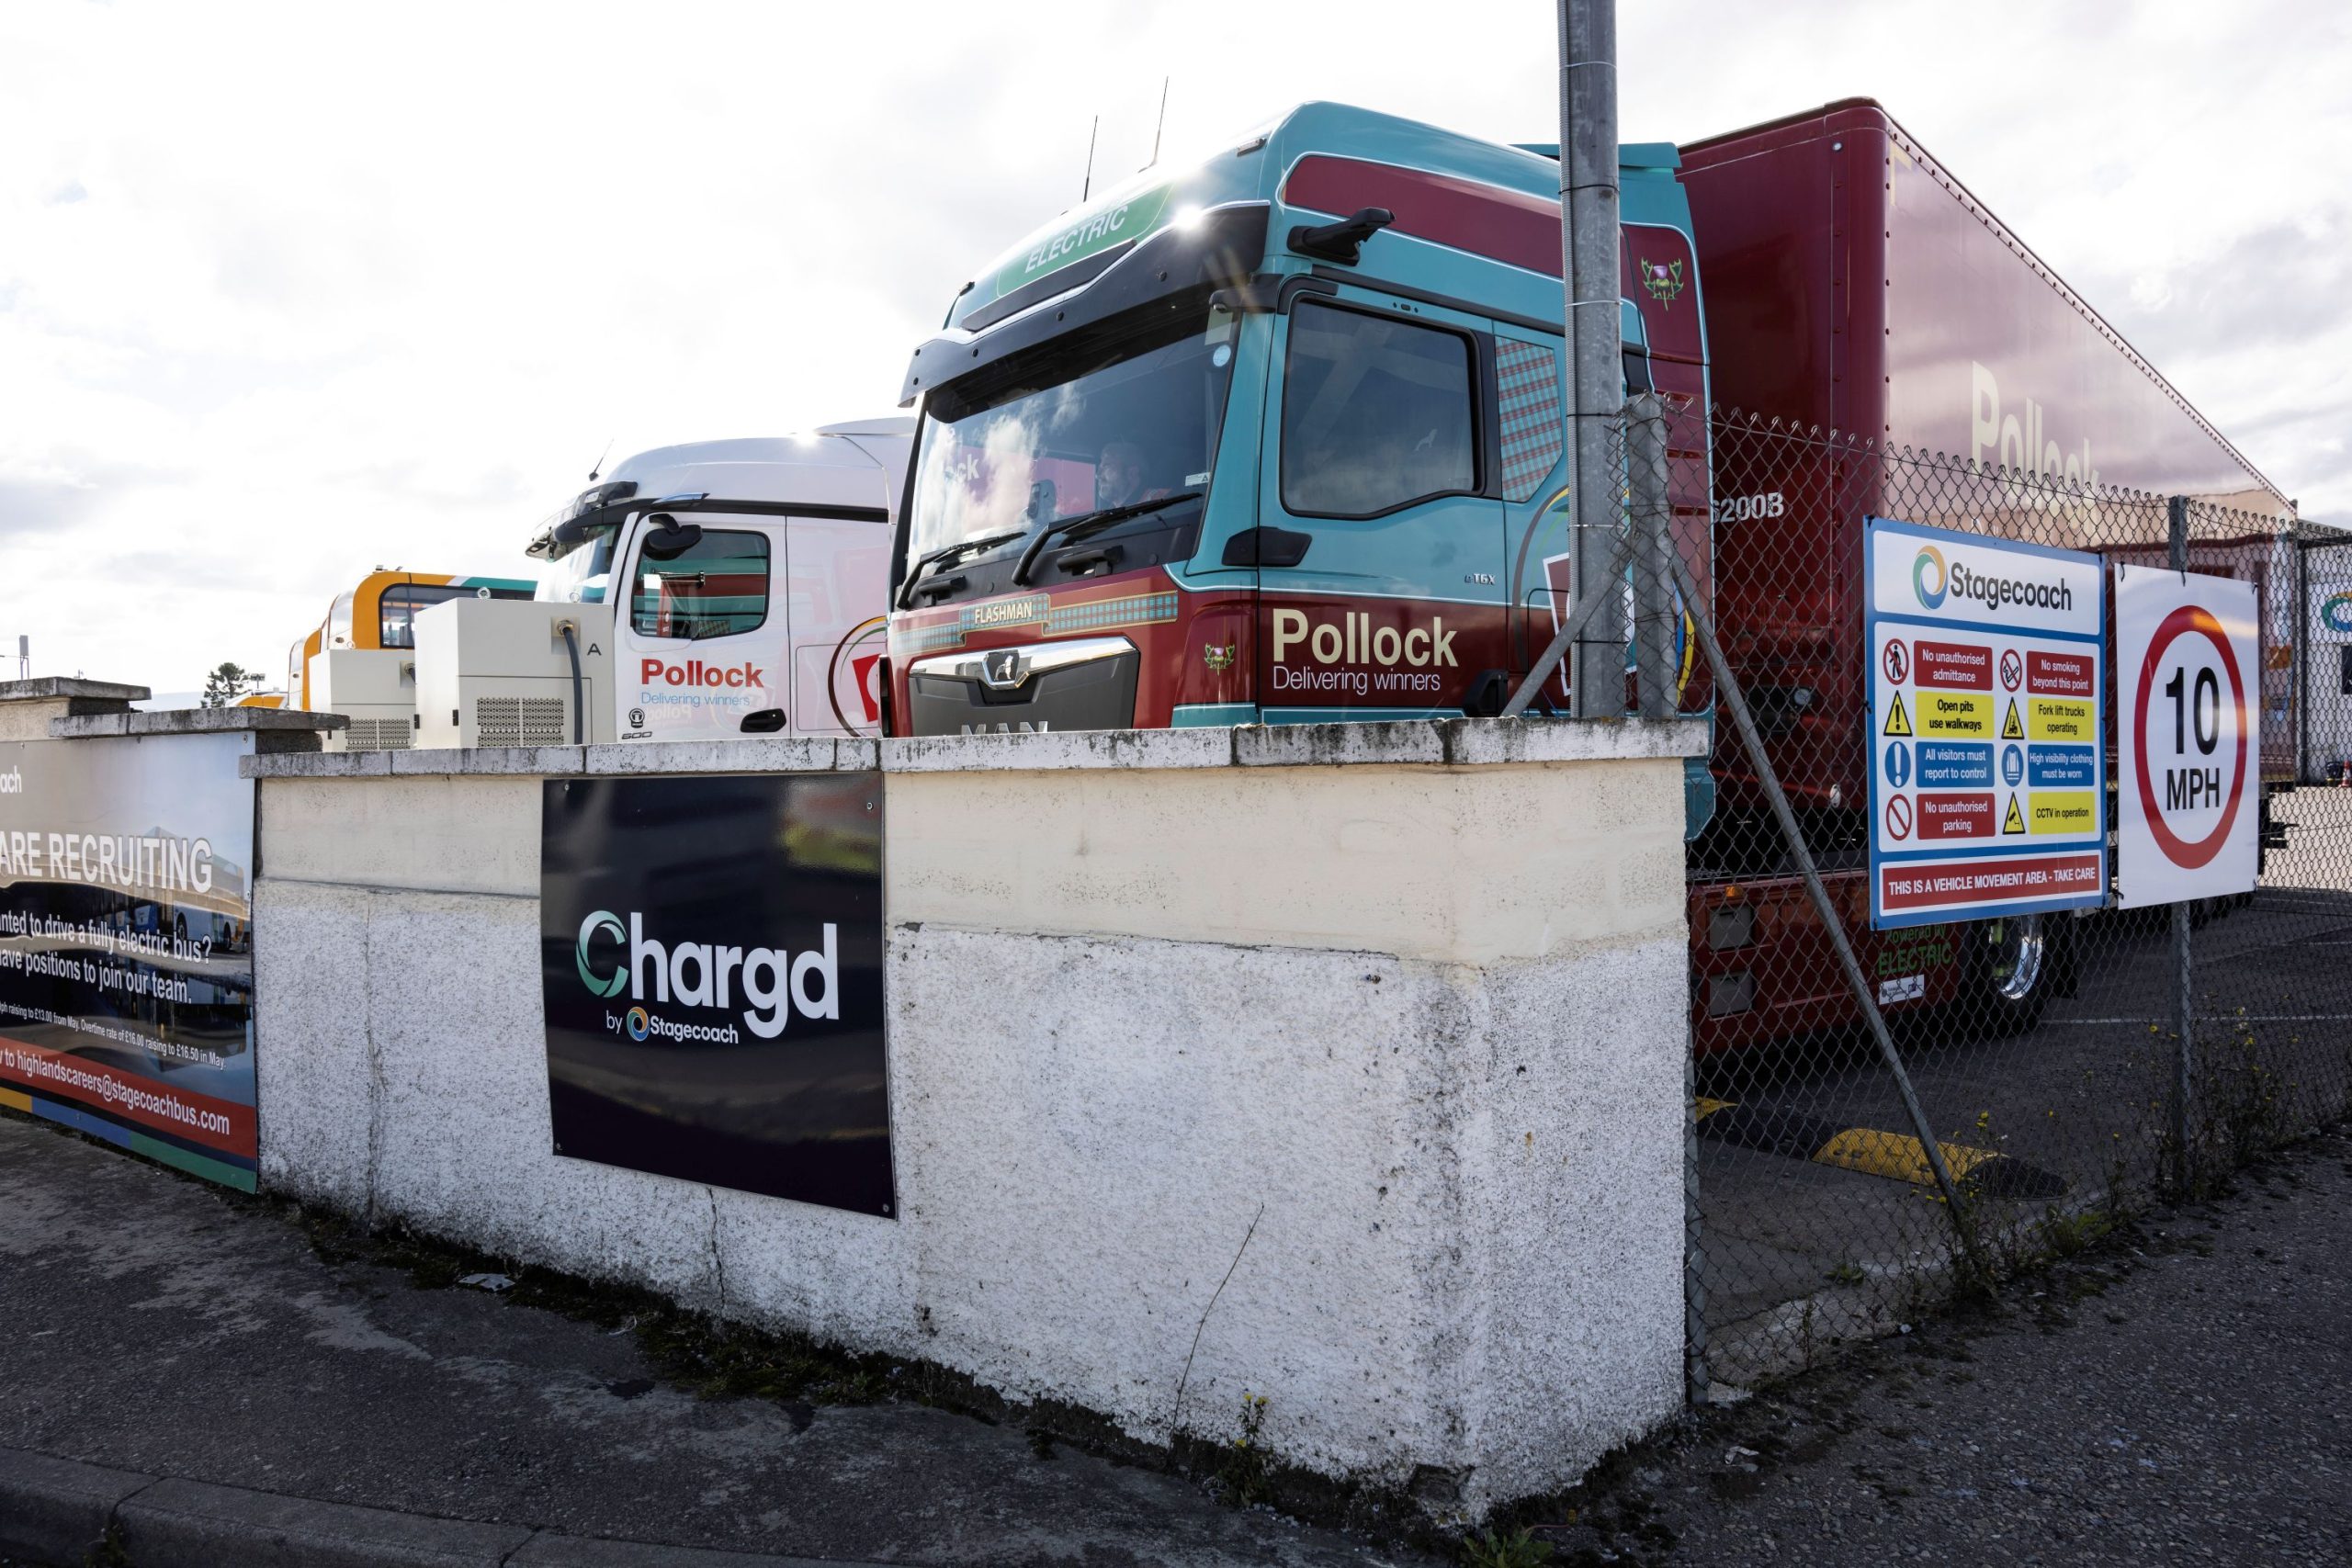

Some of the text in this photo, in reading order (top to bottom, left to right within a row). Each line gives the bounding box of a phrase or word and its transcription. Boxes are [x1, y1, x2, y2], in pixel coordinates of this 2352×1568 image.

[1024, 205, 1128, 273] ELECTRIC
[1950, 561, 2072, 611] Stagecoach
[975, 602, 1033, 625] FLASHMAN
[1272, 608, 1459, 668] Pollock
[587, 643, 602, 656] A
[1922, 648, 1985, 666] No unauthorised
[641, 659, 764, 688] Pollock
[1932, 669, 1976, 682] admittance
[2041, 659, 2081, 675] No smoking
[1273, 665, 1441, 695] Delivering winners
[2032, 675, 2088, 692] beyond this point
[640, 692, 751, 707] Delivering winners
[1937, 698, 1974, 714] Open pits
[2038, 704, 2086, 716] Fork lift trucks
[2165, 667, 2221, 755] 10
[1929, 717, 1982, 732] use walkways
[2047, 723, 2078, 735] operating
[1925, 748, 1986, 761] All visitors must
[2030, 752, 2093, 765] High visibility clothing
[1925, 767, 1987, 781] report to control
[2041, 768, 2083, 778] must be worn
[2166, 767, 2221, 811] MPH
[1925, 800, 1987, 814] No unauthorised
[2036, 807, 2089, 819] CCTV in operation
[1943, 818, 1972, 833] parking
[0, 831, 212, 894] ARE RECRUITING
[1888, 880, 1912, 896] THIS
[1914, 879, 1923, 894] IS
[1925, 878, 1932, 893] A
[1933, 875, 1973, 892] VEHICLE
[1974, 872, 2024, 889] MOVEMENT
[2025, 870, 2048, 885] AREA
[2053, 868, 2074, 882] TAKE
[2075, 867, 2096, 880] CARE
[0, 909, 212, 964] nted to drive a fully electric bus?
[1878, 942, 1952, 976] ELECTRIC
[0, 948, 191, 1004] ave positions to join our team.
[576, 909, 840, 1039] Chargd
[8, 1003, 28, 1021] raising
[28, 1007, 35, 1019] to
[35, 1008, 52, 1023] £13.00
[53, 1011, 67, 1026] from
[81, 1019, 106, 1036] Overtime
[106, 1028, 117, 1040] rate
[118, 1030, 125, 1042] of
[125, 1031, 144, 1047] £16.00
[145, 1037, 167, 1056] raising
[168, 1042, 175, 1055] to
[176, 1043, 199, 1062] £16.50
[199, 1049, 208, 1063] in
[209, 1051, 227, 1070] May.
[606, 1009, 739, 1044] by Stagecoach
[5, 1047, 230, 1135] to highlandscareers@stagecoachbus.com
